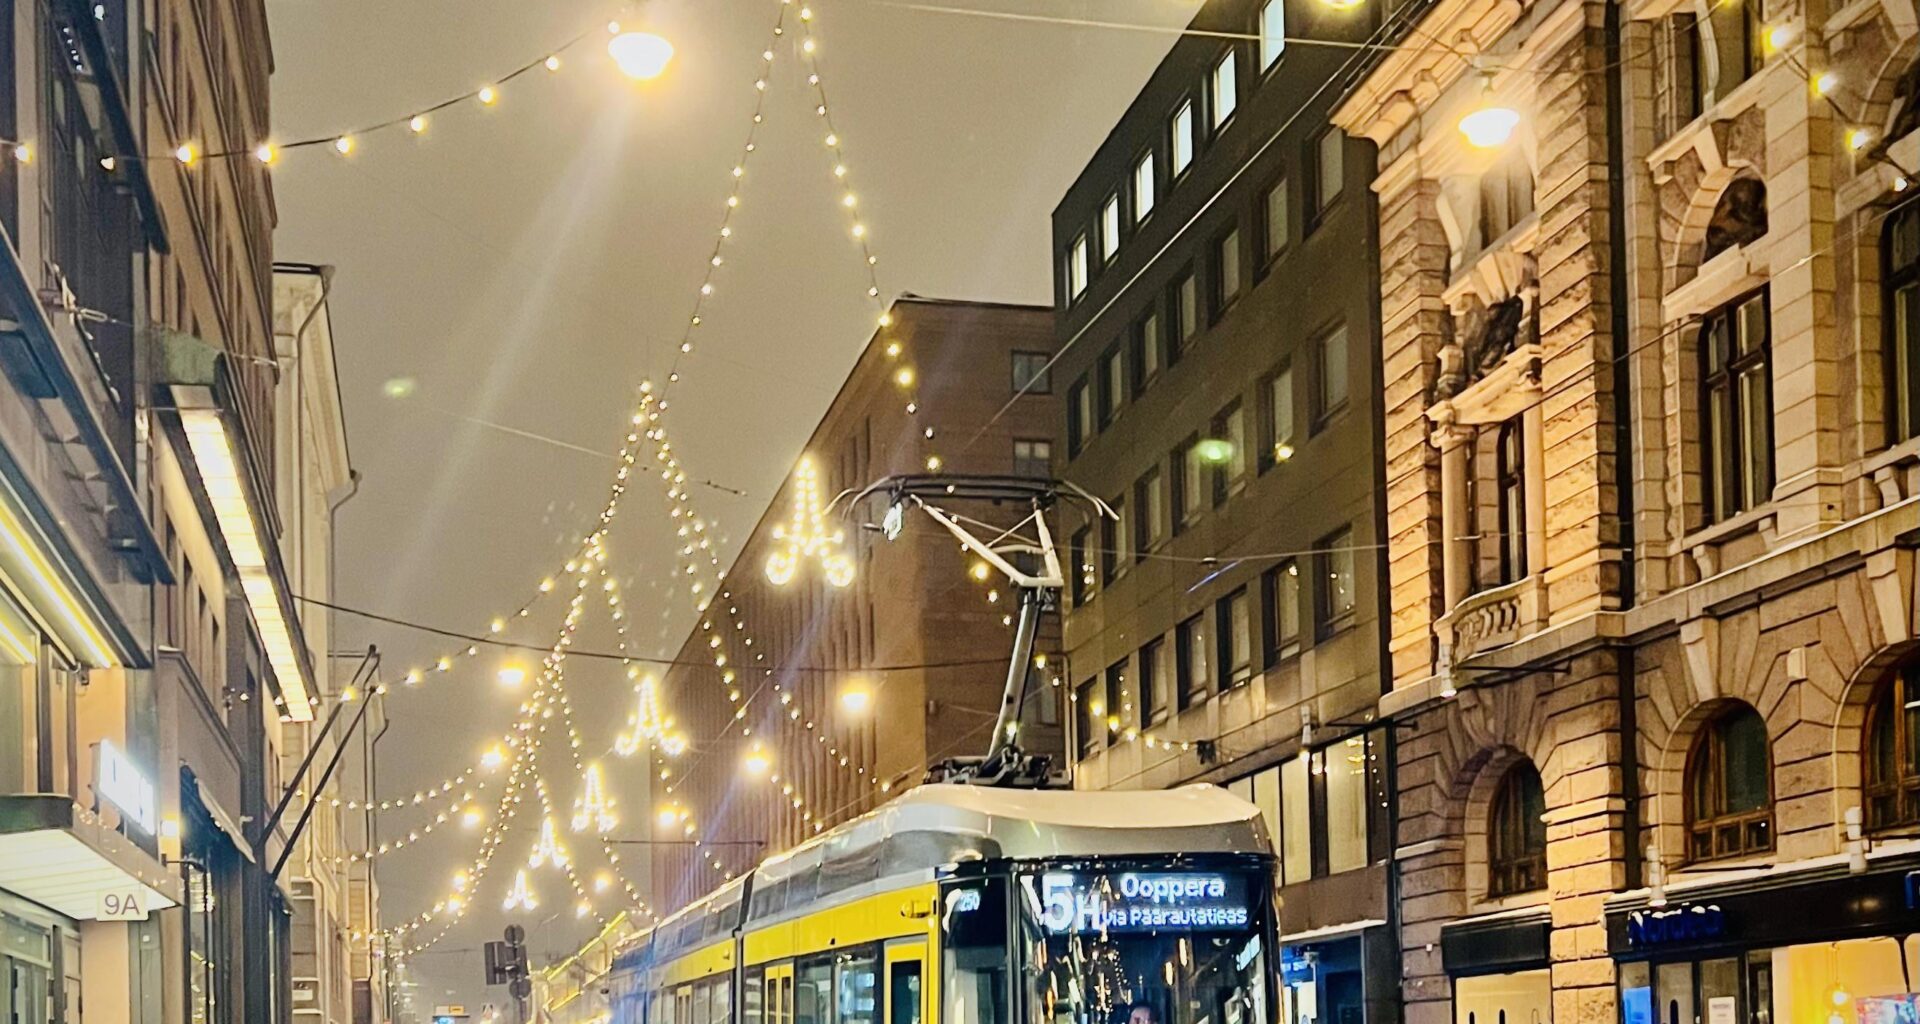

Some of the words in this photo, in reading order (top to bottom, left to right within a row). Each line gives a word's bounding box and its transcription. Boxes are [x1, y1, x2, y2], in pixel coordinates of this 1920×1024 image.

[1120, 873, 1225, 902] Ooppera
[104, 894, 140, 915] 9A
[1102, 908, 1127, 926] via
